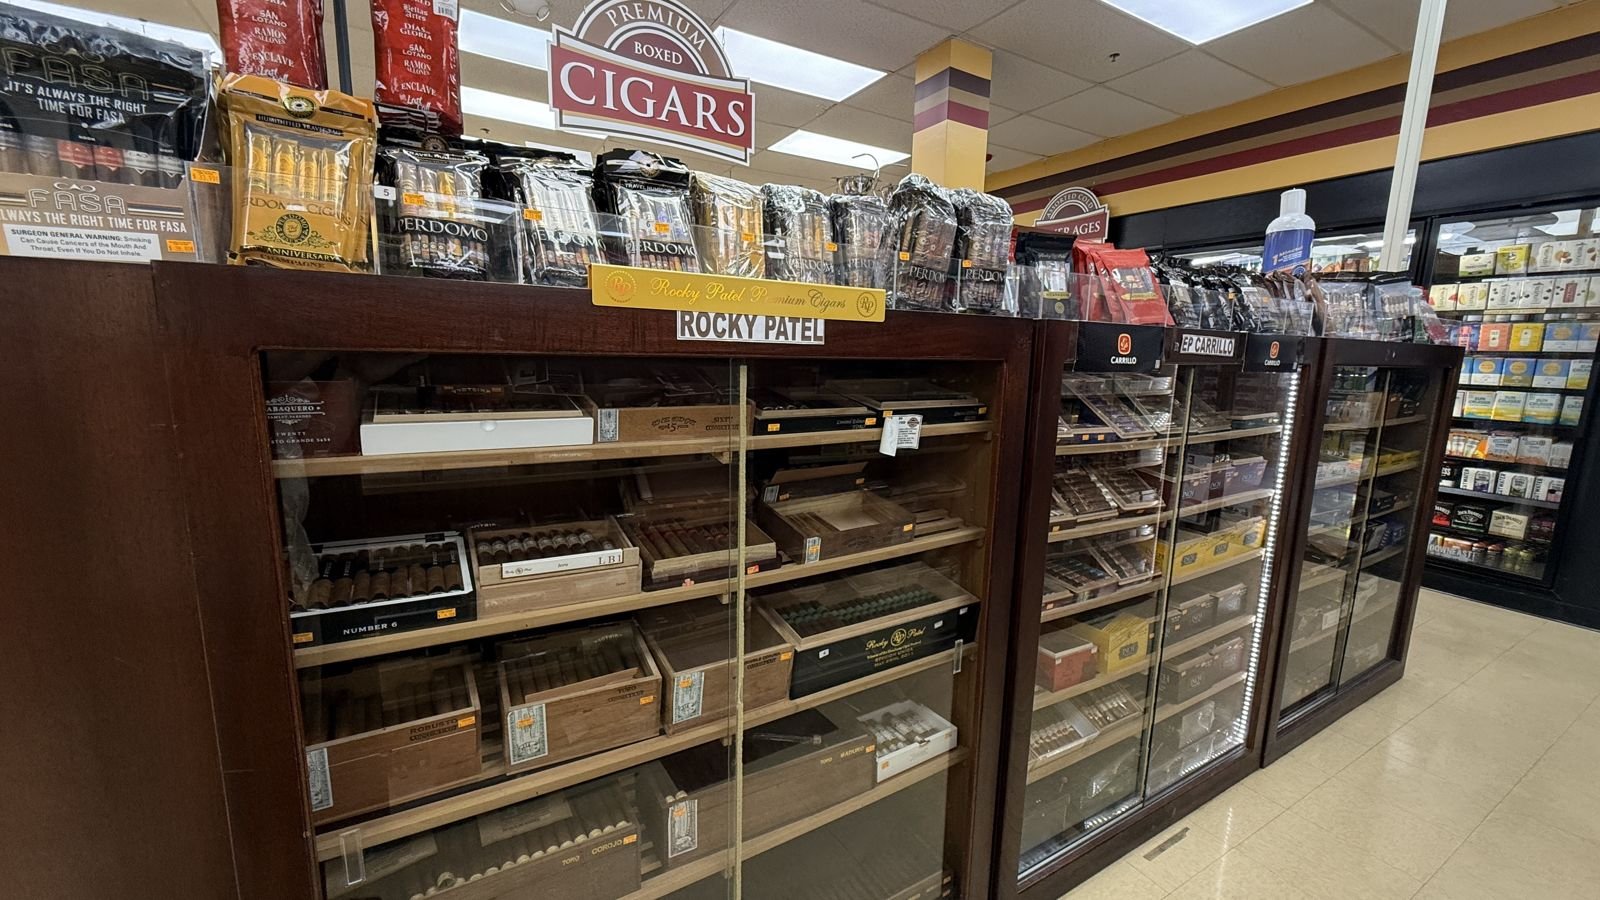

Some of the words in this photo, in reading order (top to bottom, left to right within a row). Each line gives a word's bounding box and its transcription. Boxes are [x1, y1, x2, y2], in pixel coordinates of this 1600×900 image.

[251, 16, 288, 28] LOTANO
[259, 10, 279, 20] SAN
[254, 27, 288, 40] RAMON
[400, 28, 432, 41] GLORIA
[605, 3, 707, 51] PREMIUM
[402, 49, 432, 60] LOTANO
[408, 44, 425, 53] SAN
[633, 42, 683, 65] BOXED
[252, 51, 295, 68] ENCLAVE
[403, 60, 432, 71] RAMON
[1, 46, 150, 101] FASA
[401, 82, 437, 96] ENCLAVE
[37, 86, 86, 104] ALWAYS
[89, 94, 111, 108] THE
[114, 99, 147, 115] RIGHT
[559, 62, 745, 137] CIGARS
[36, 98, 67, 114] TIME
[69, 103, 93, 118] FOR
[96, 109, 126, 124] FASA
[53, 182, 97, 193] CAO
[383, 189, 390, 197] 5
[27, 188, 127, 215] FASA
[1077, 193, 1094, 209] COLD
[0, 207, 40, 223] LWAYS
[44, 211, 67, 225] THE
[70, 214, 104, 228] RIGHT
[107, 217, 134, 230] TIME
[136, 219, 157, 231] FOR
[160, 221, 188, 233] FASA
[11, 228, 48, 238] SURGEON
[50, 231, 83, 240] GENERAL
[85, 233, 122, 241] WARNING:
[124, 236, 152, 245] Smoking
[20, 236, 35, 244] Can
[36, 237, 58, 246] Cause
[60, 239, 89, 247] Cancers
[111, 242, 132, 250] Mouth
[266, 247, 336, 262] ANNIVERSARY
[649, 276, 700, 305] Rocky
[704, 281, 745, 300] Patel
[807, 288, 846, 314] Cigars
[679, 310, 757, 340] ROCKY
[764, 315, 824, 342] PATEL
[1182, 336, 1194, 350] EP
[1194, 338, 1234, 356] CARRILLO
[1110, 355, 1137, 365] CARRILLO
[266, 405, 314, 413] ABAQUERO
[343, 623, 388, 635] NUMBER
[409, 718, 457, 735] ROBUSTO
[591, 839, 623, 855] COROJO
